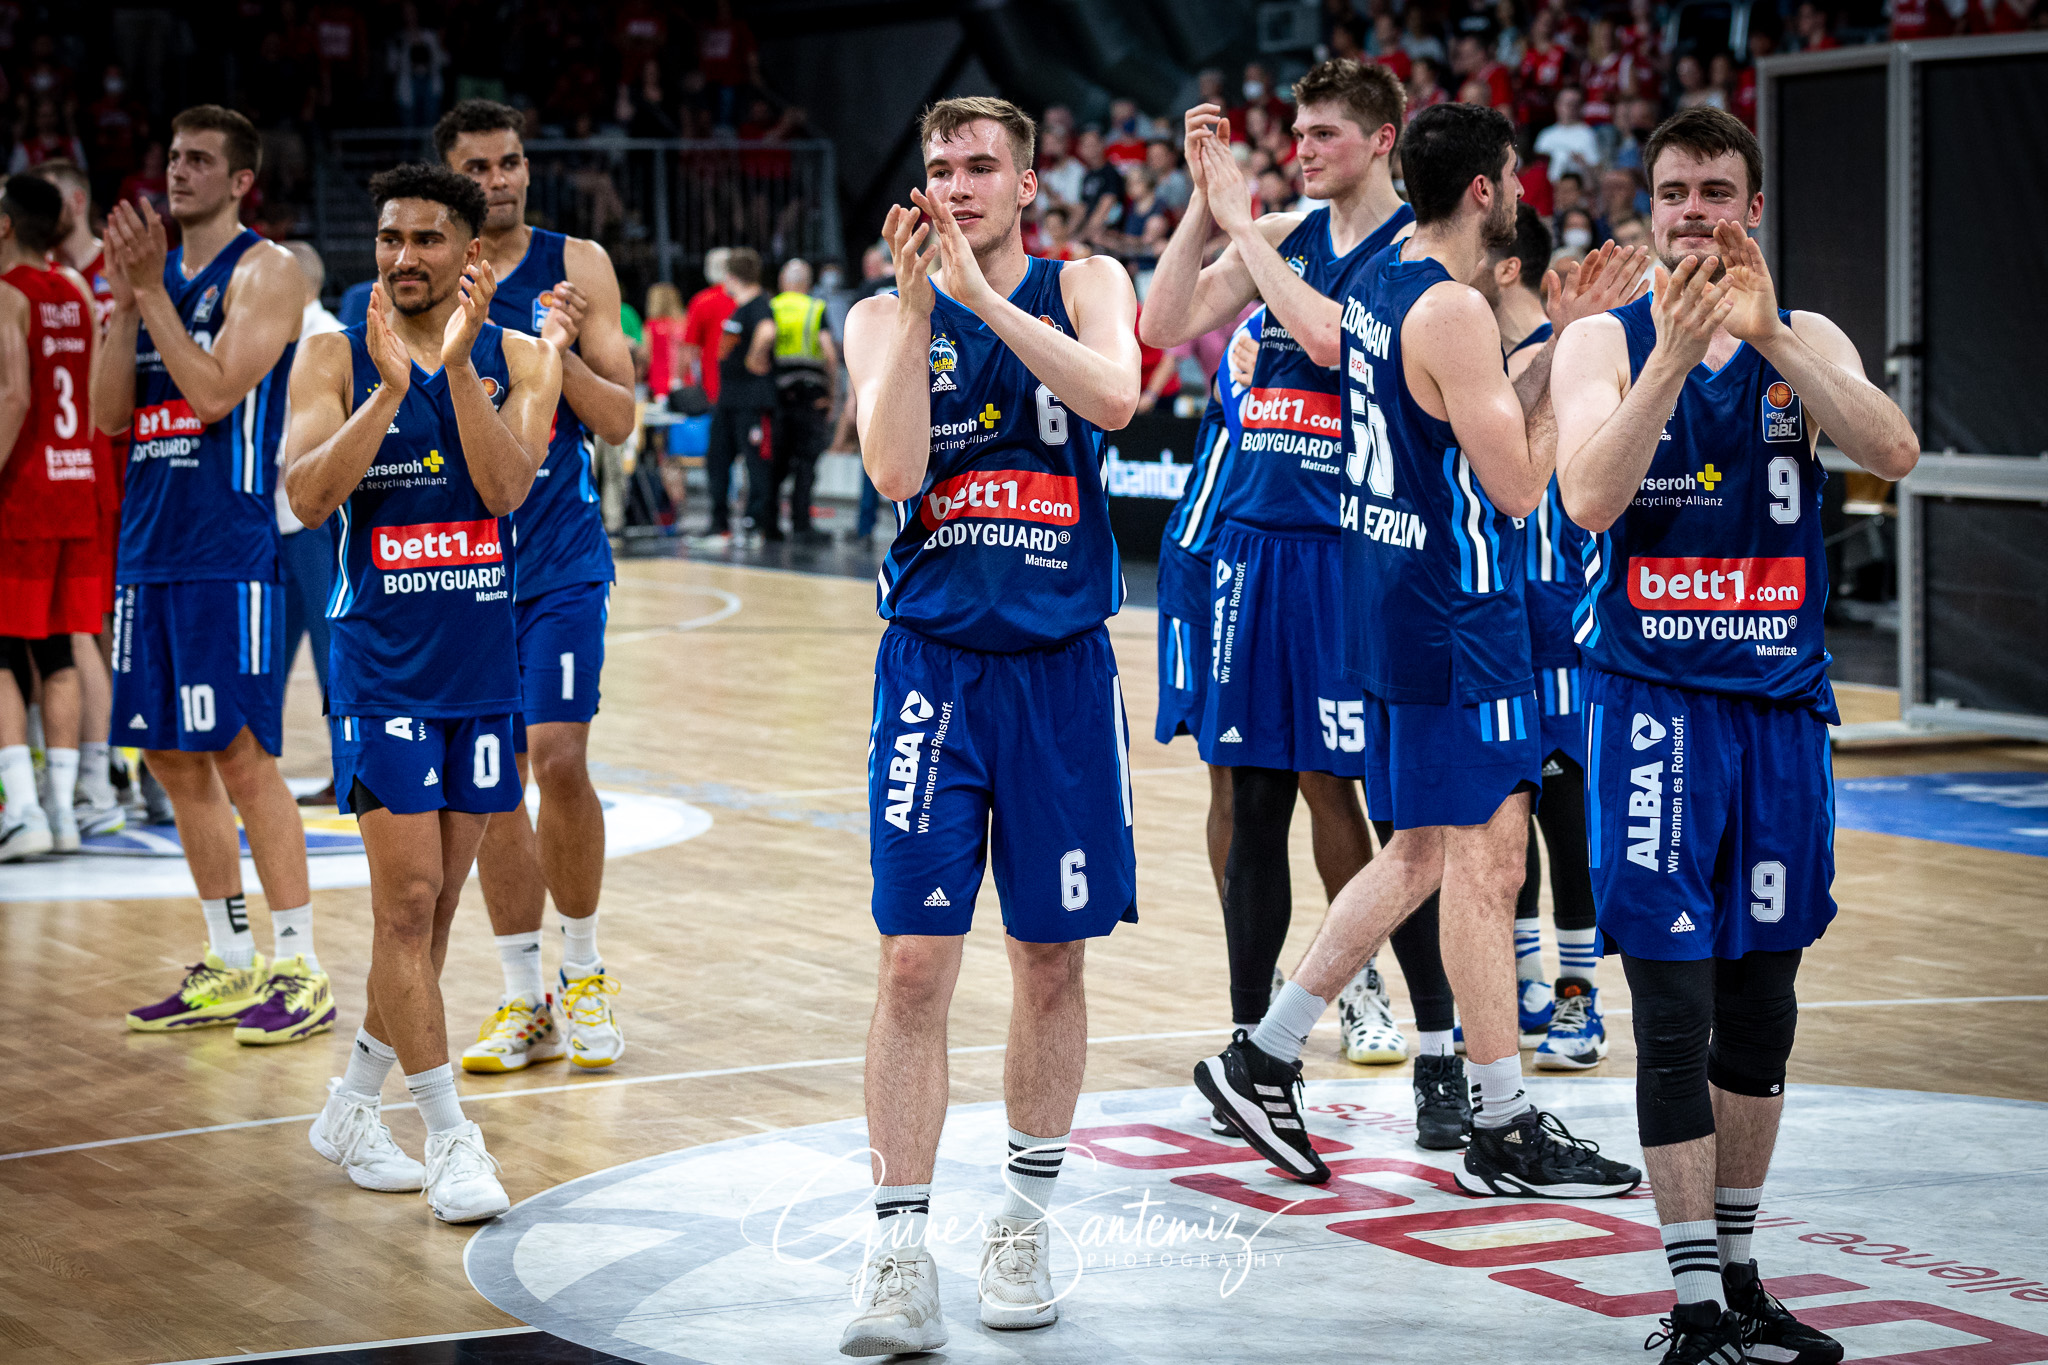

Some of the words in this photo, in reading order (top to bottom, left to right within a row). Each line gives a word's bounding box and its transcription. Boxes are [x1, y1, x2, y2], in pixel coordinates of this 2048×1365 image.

[53, 365, 78, 440] 3
[931, 384, 957, 393] adidas
[930, 418, 978, 437] rseroh
[1035, 382, 1069, 445] 6
[1768, 424, 1796, 437] BBL
[367, 475, 448, 491] Recycling-Allianz
[1301, 458, 1340, 475] Matratze
[1640, 474, 1696, 491] rseroh
[929, 480, 1073, 520] bett1.com
[1768, 456, 1801, 524] 9
[1025, 553, 1068, 570] Matratze
[476, 590, 508, 603] Matratze
[1229, 561, 1247, 608] Rohstoff.
[1640, 566, 1799, 602] bett1.com
[1228, 609, 1238, 623] es
[1224, 624, 1236, 664] nennen
[1755, 644, 1797, 656] Matratze
[560, 652, 574, 700] 1
[1220, 665, 1231, 684] Wir
[180, 683, 216, 733] 10
[931, 701, 954, 749] Rohstoff.
[1318, 696, 1366, 753] 55
[473, 733, 500, 789] 0
[930, 749, 940, 763] es
[1671, 714, 1685, 774] Rohstoff.
[884, 732, 926, 833] ALBA
[922, 766, 938, 810] nennen
[1673, 777, 1684, 794] es
[917, 813, 930, 834] Wir
[1626, 760, 1664, 872] ALBA
[1671, 797, 1683, 848] nennen
[1060, 848, 1089, 912] 6
[1667, 849, 1680, 874] Wir
[924, 898, 950, 907] adidas
[1751, 860, 1786, 923] 9
[1670, 924, 1696, 934] adidas
